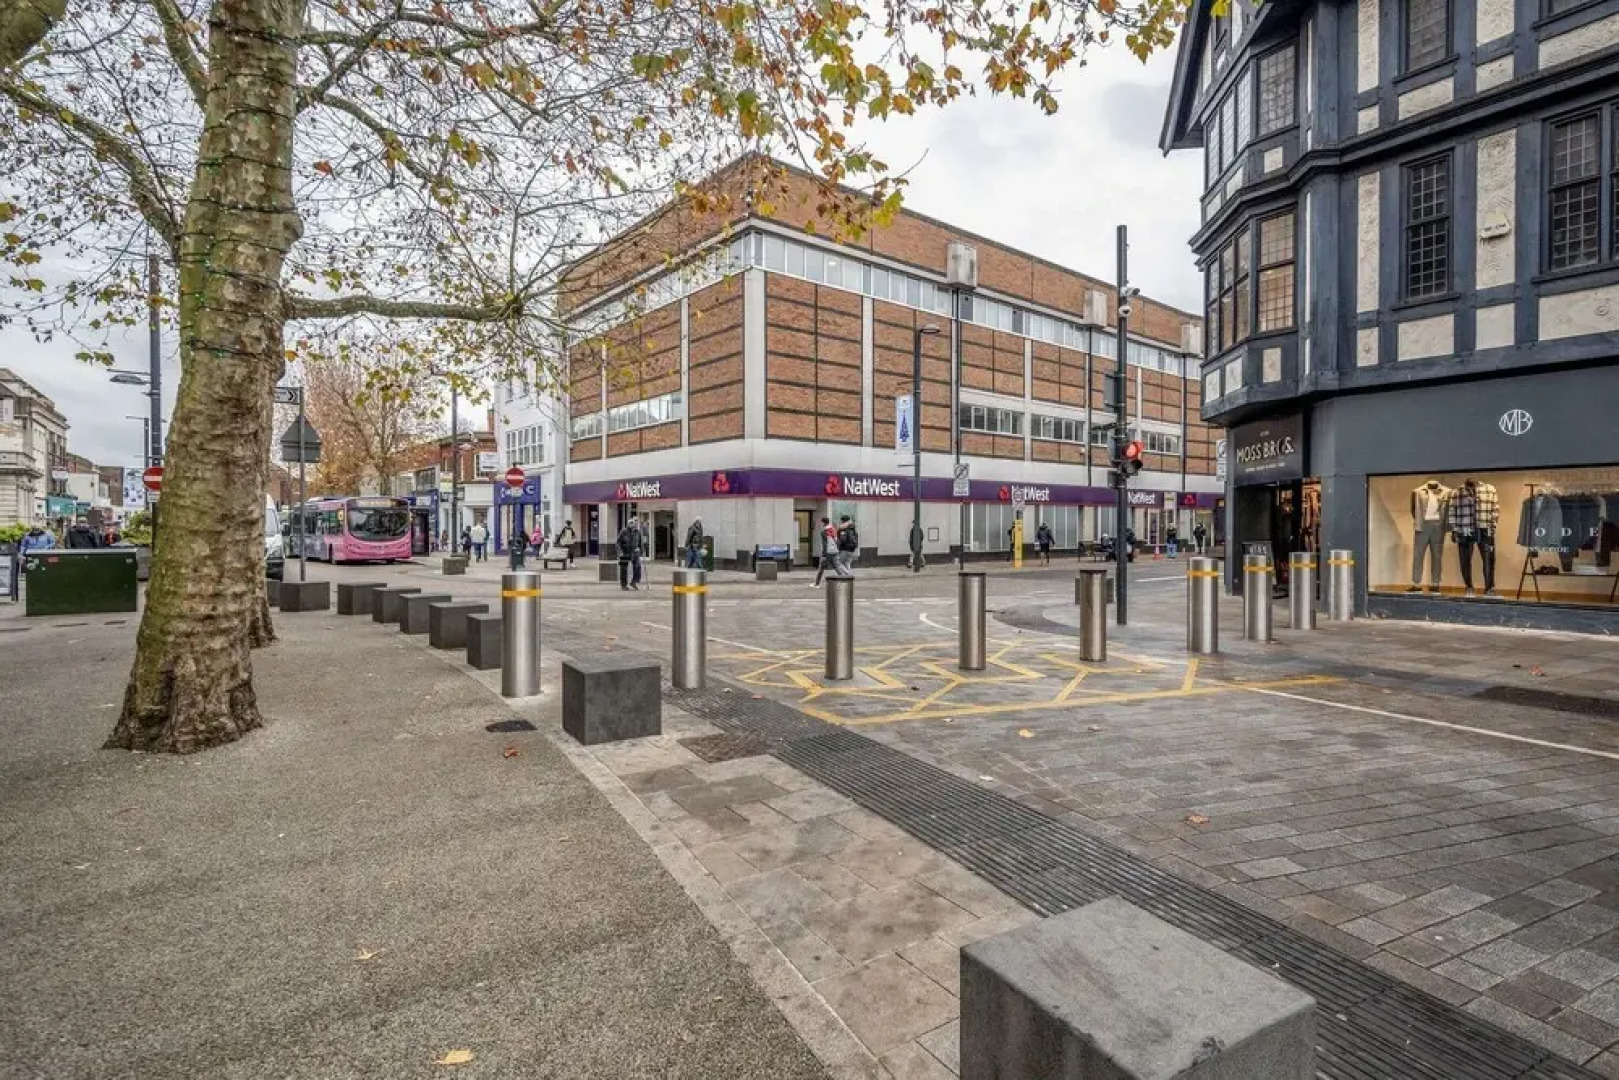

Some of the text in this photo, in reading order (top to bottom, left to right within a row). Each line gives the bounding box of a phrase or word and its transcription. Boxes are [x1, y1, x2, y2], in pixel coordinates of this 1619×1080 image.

[1236, 443, 1262, 464] MOSS
[625, 480, 661, 498] NatWest
[843, 477, 901, 497] NatWest
[1127, 491, 1156, 505] NatWest
